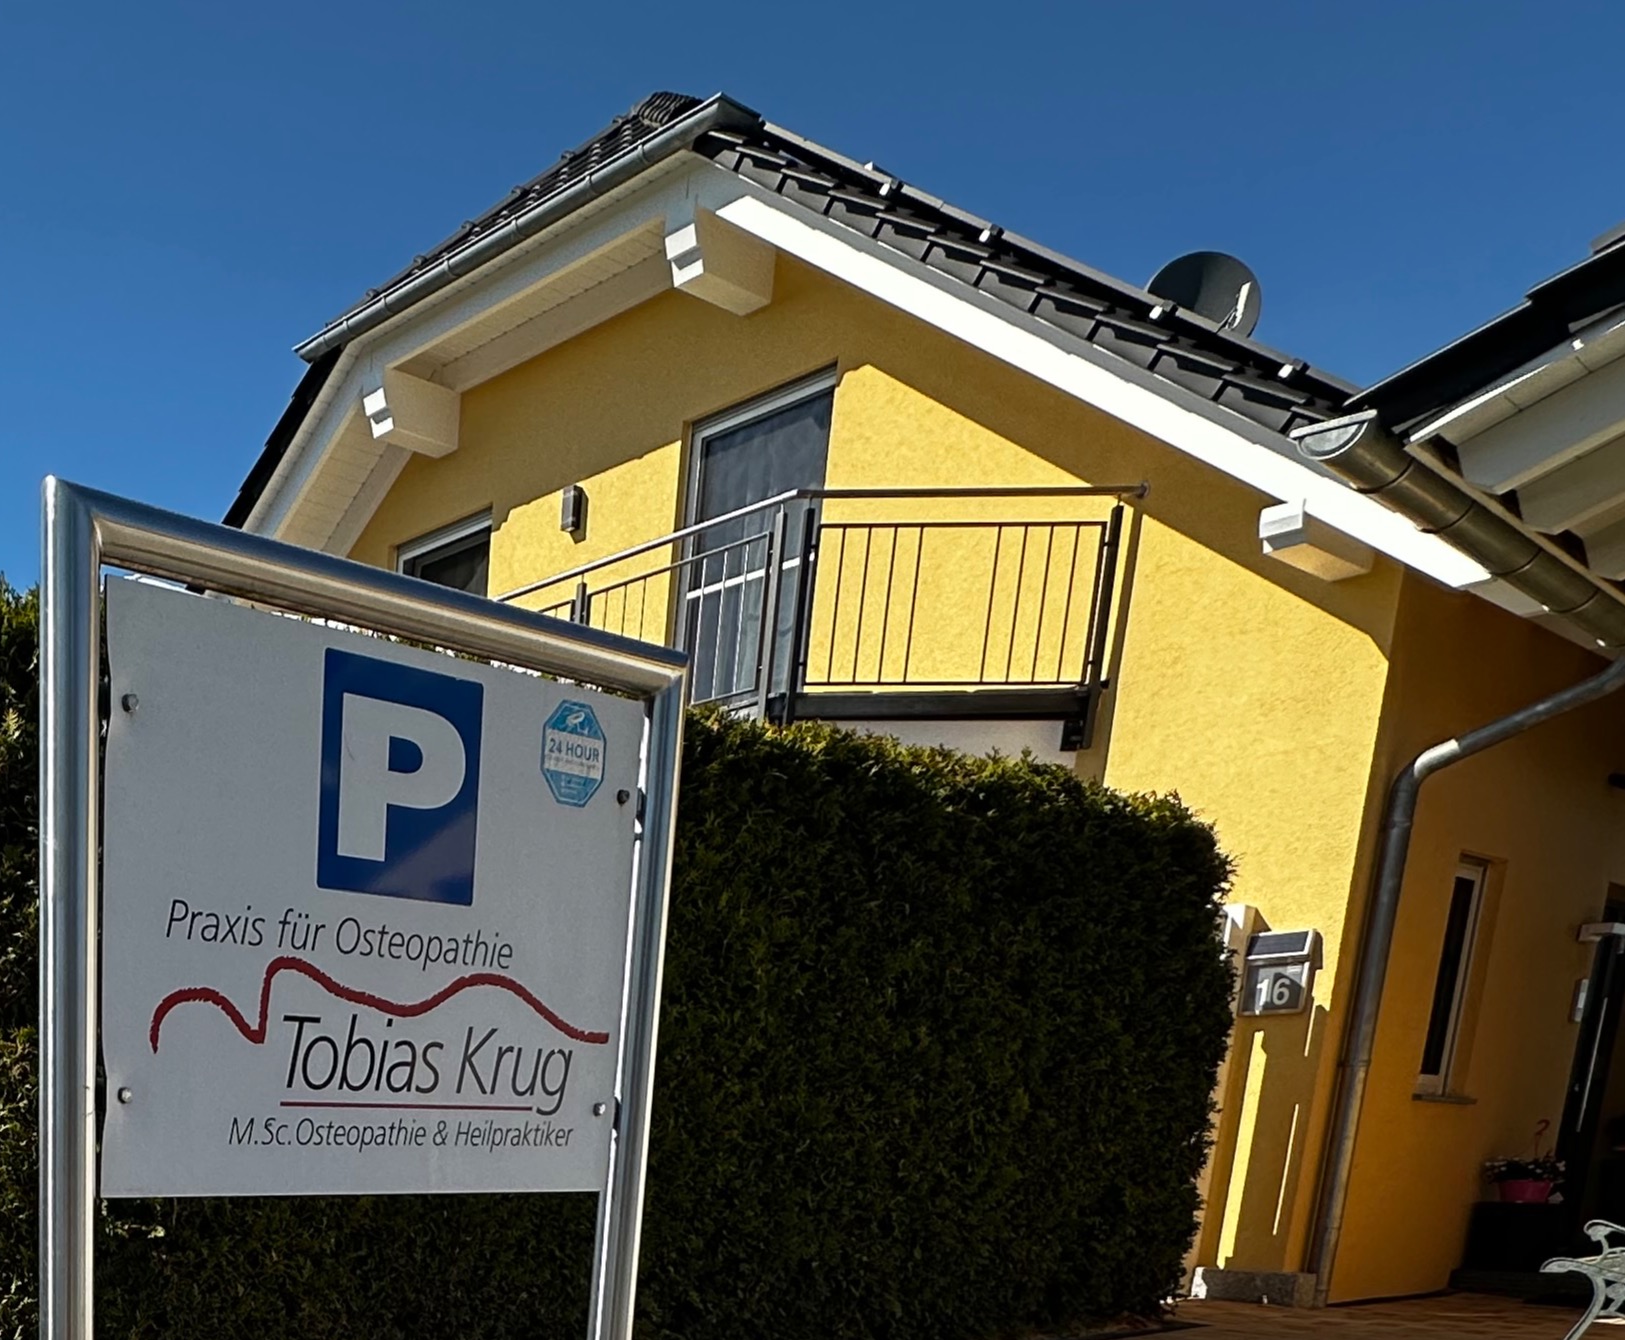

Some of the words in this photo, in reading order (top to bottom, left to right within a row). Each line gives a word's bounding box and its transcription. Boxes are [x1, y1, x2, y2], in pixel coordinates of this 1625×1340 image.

[548, 737, 563, 755] 24
[565, 740, 600, 763] HOUR
[337, 691, 467, 864] P
[164, 898, 265, 948] Praxis
[277, 908, 326, 954] für
[335, 916, 513, 971] Osteopathie
[1255, 977, 1291, 1006] 16
[282, 1013, 444, 1094] Tobias
[454, 1025, 573, 1116] Krug
[432, 1121, 450, 1147] &
[453, 1121, 574, 1153] Heilpraktiker
